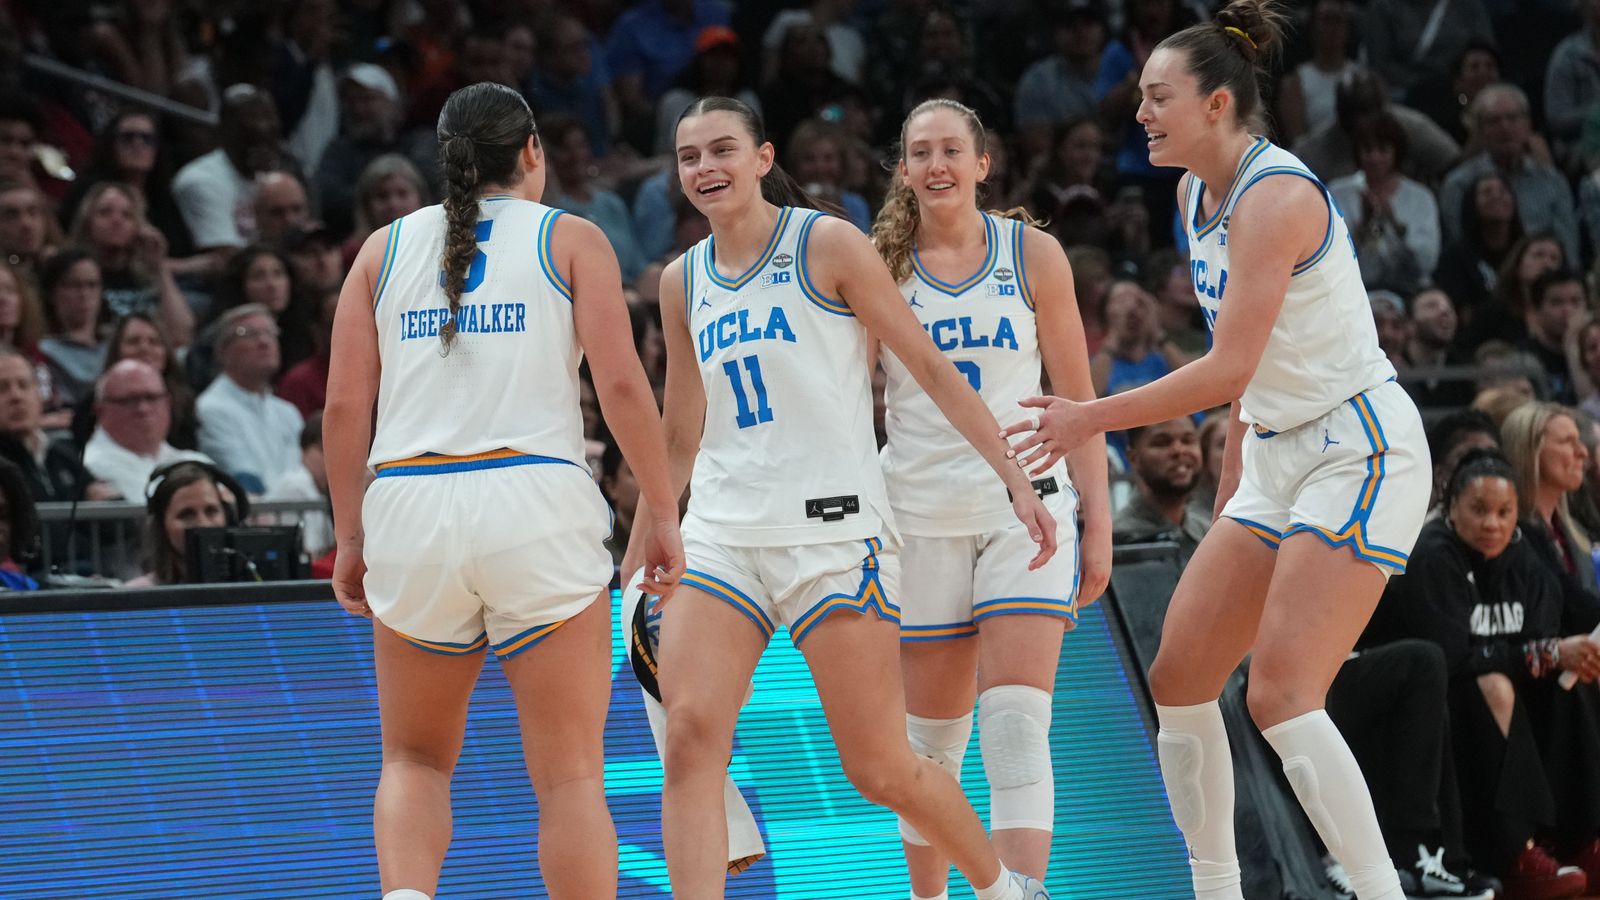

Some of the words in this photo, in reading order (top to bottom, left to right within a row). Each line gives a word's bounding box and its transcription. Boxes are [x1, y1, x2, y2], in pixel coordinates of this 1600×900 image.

[698, 306, 797, 363] UCLA
[923, 316, 1019, 351] CLA
[722, 354, 774, 429] 11
